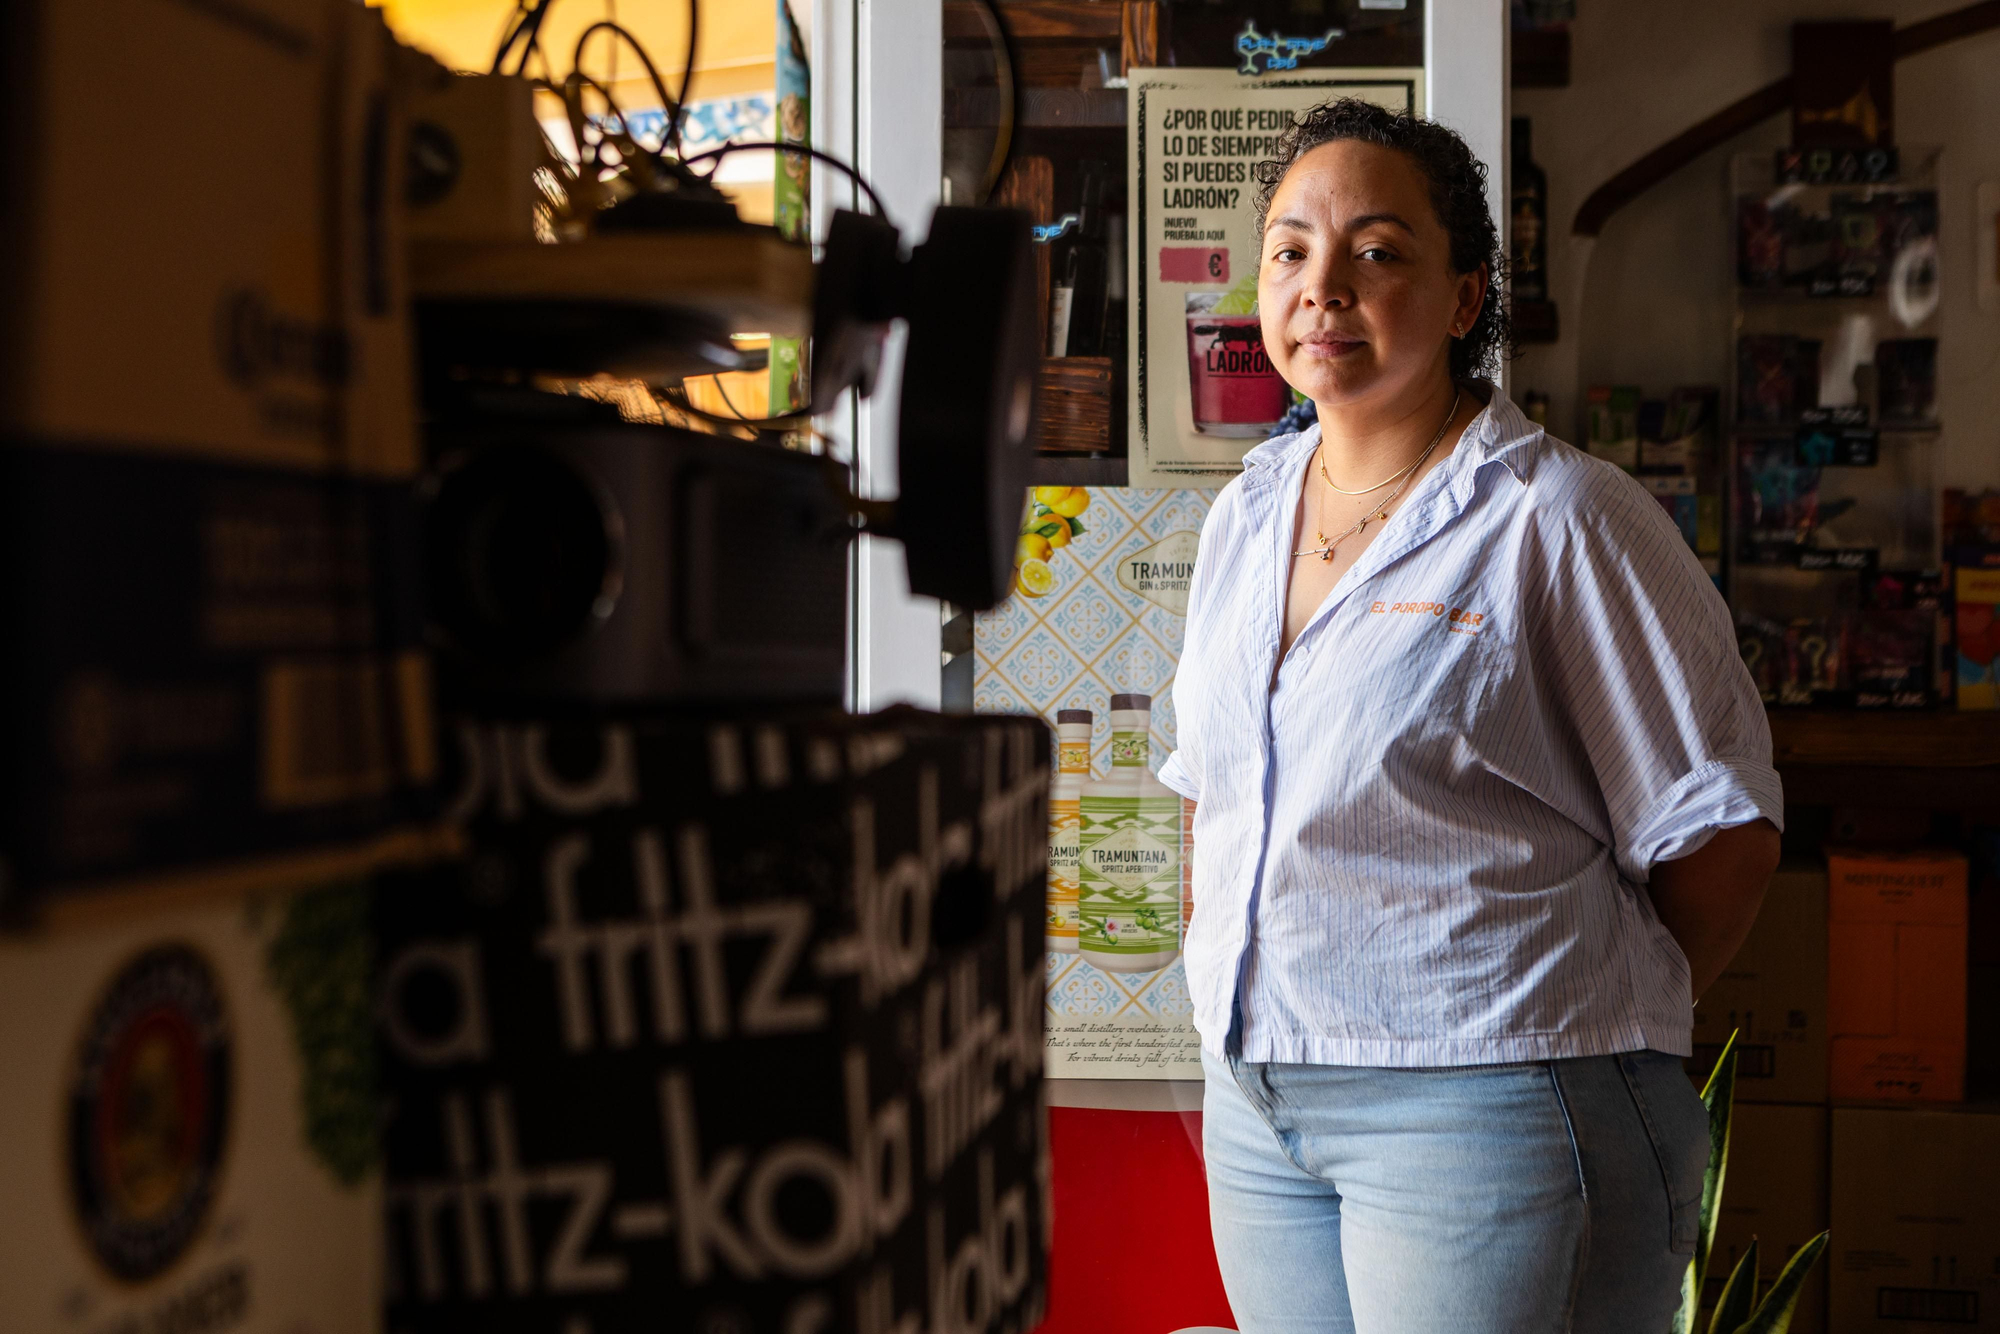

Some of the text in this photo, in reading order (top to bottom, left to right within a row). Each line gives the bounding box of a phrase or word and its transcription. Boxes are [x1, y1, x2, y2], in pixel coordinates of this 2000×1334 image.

[1163, 109, 1207, 131] ¿POR
[1211, 107, 1243, 133] QUÉ
[1163, 135, 1183, 157] LO
[1187, 135, 1208, 157] DE
[1163, 162, 1179, 183] SI
[1183, 162, 1246, 183] PUEDES
[1163, 186, 1240, 209] LADRÓN?
[1131, 562, 1196, 580] TRAMUN
[1139, 581, 1153, 591] GIN
[1160, 581, 1188, 591] SPRITZ
[1370, 601, 1485, 626] EL POROPO BAR
[1092, 849, 1168, 864] TRAMUNTANA
[1101, 865, 1159, 874] SPRITZ APERITIVO
[1063, 1023, 1087, 1033] small
[1087, 1023, 1125, 1038] distillery
[1126, 1023, 1171, 1038] overlooking
[1173, 1024, 1186, 1033] the
[1045, 1037, 1071, 1048] That's
[1073, 1038, 1097, 1048] where
[1099, 1038, 1111, 1048] the
[1112, 1037, 1133, 1051] first
[1134, 1038, 1182, 1053] handcrafted
[1066, 1052, 1082, 1062] For
[1083, 1052, 1113, 1062] vibrant
[1114, 1052, 1141, 1063] drinks
[1137, 1052, 1160, 1067] full
[1158, 1052, 1172, 1067] of
[1173, 1053, 1187, 1063] the
